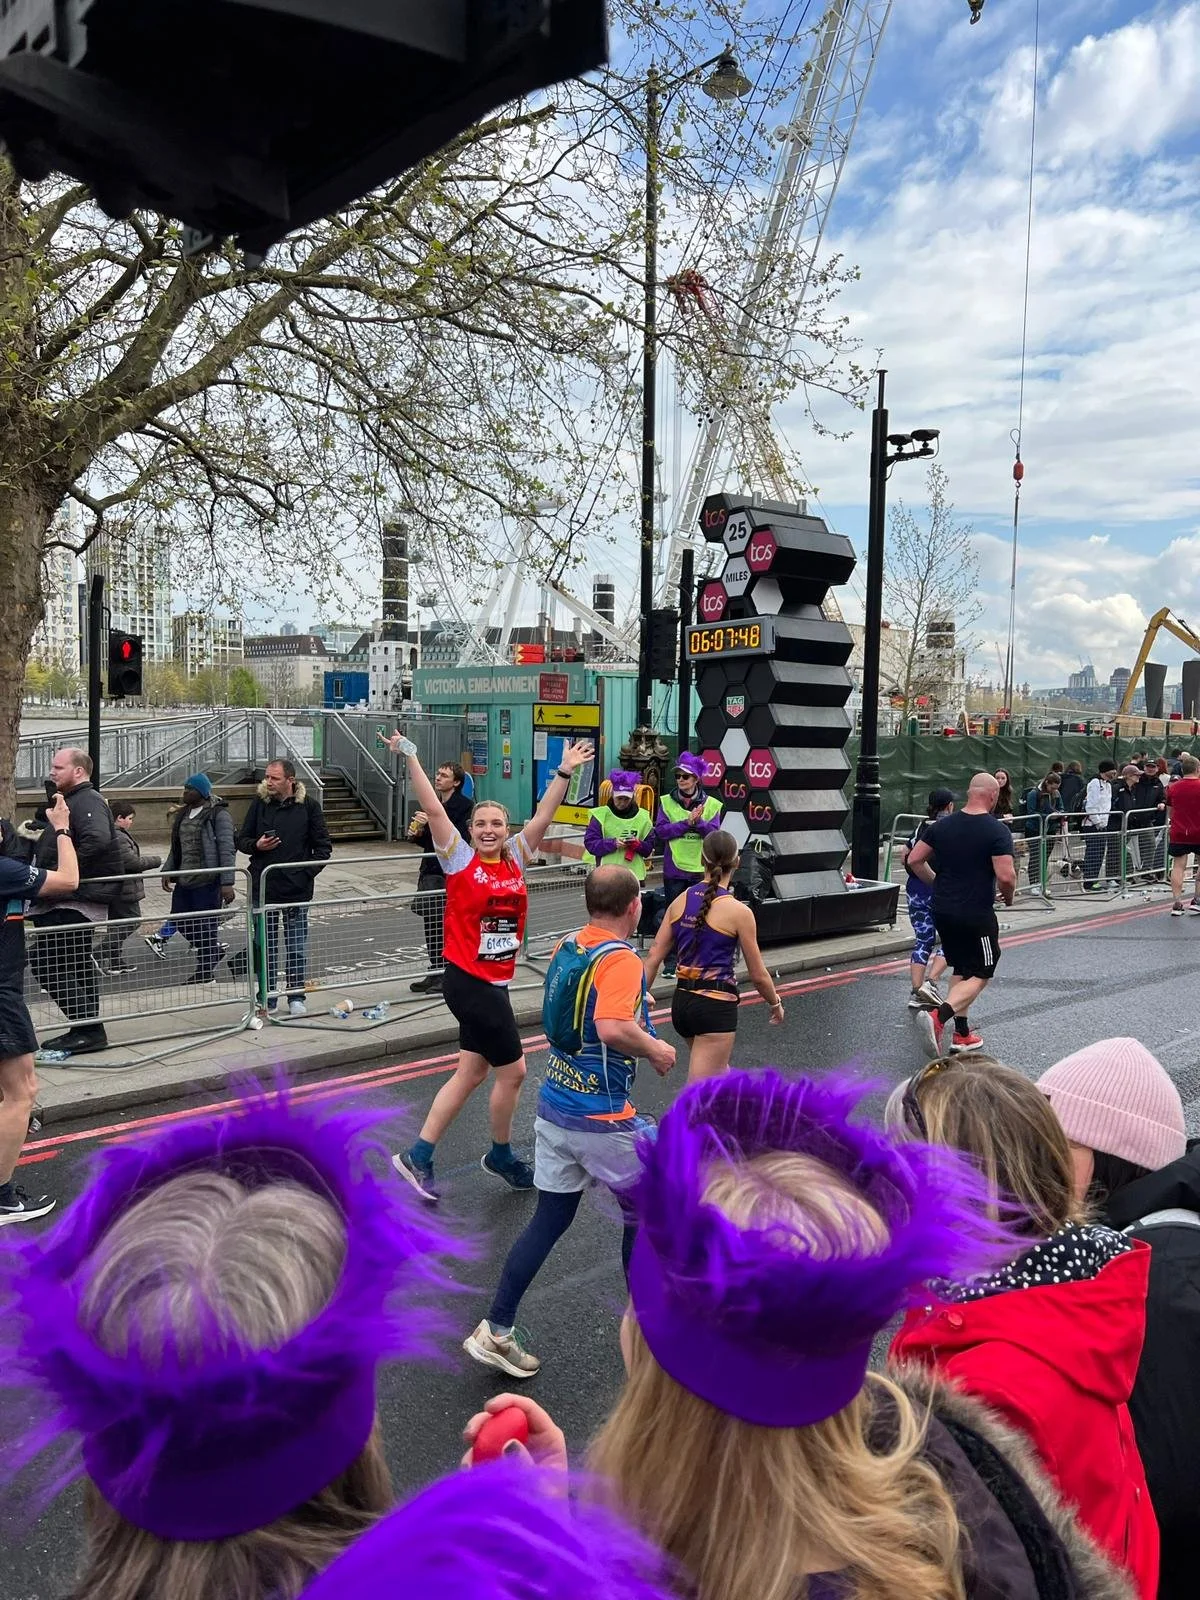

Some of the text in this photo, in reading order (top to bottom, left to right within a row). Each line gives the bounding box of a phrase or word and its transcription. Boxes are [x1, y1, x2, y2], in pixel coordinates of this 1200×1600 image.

[705, 508, 726, 528] tcs
[728, 521, 747, 542] 25
[751, 543, 772, 562] tcs
[725, 570, 748, 584] MILES
[703, 593, 724, 612] tcs
[690, 624, 760, 655] 06:07:48
[424, 678, 466, 694] VICTORIA
[728, 697, 743, 705] TAG
[749, 758, 772, 778] tcs
[724, 779, 746, 798] tcs
[749, 801, 772, 821] tcs
[487, 937, 513, 950] 61476
[548, 1053, 583, 1082] THIRSK
[587, 1073, 599, 1086] &
